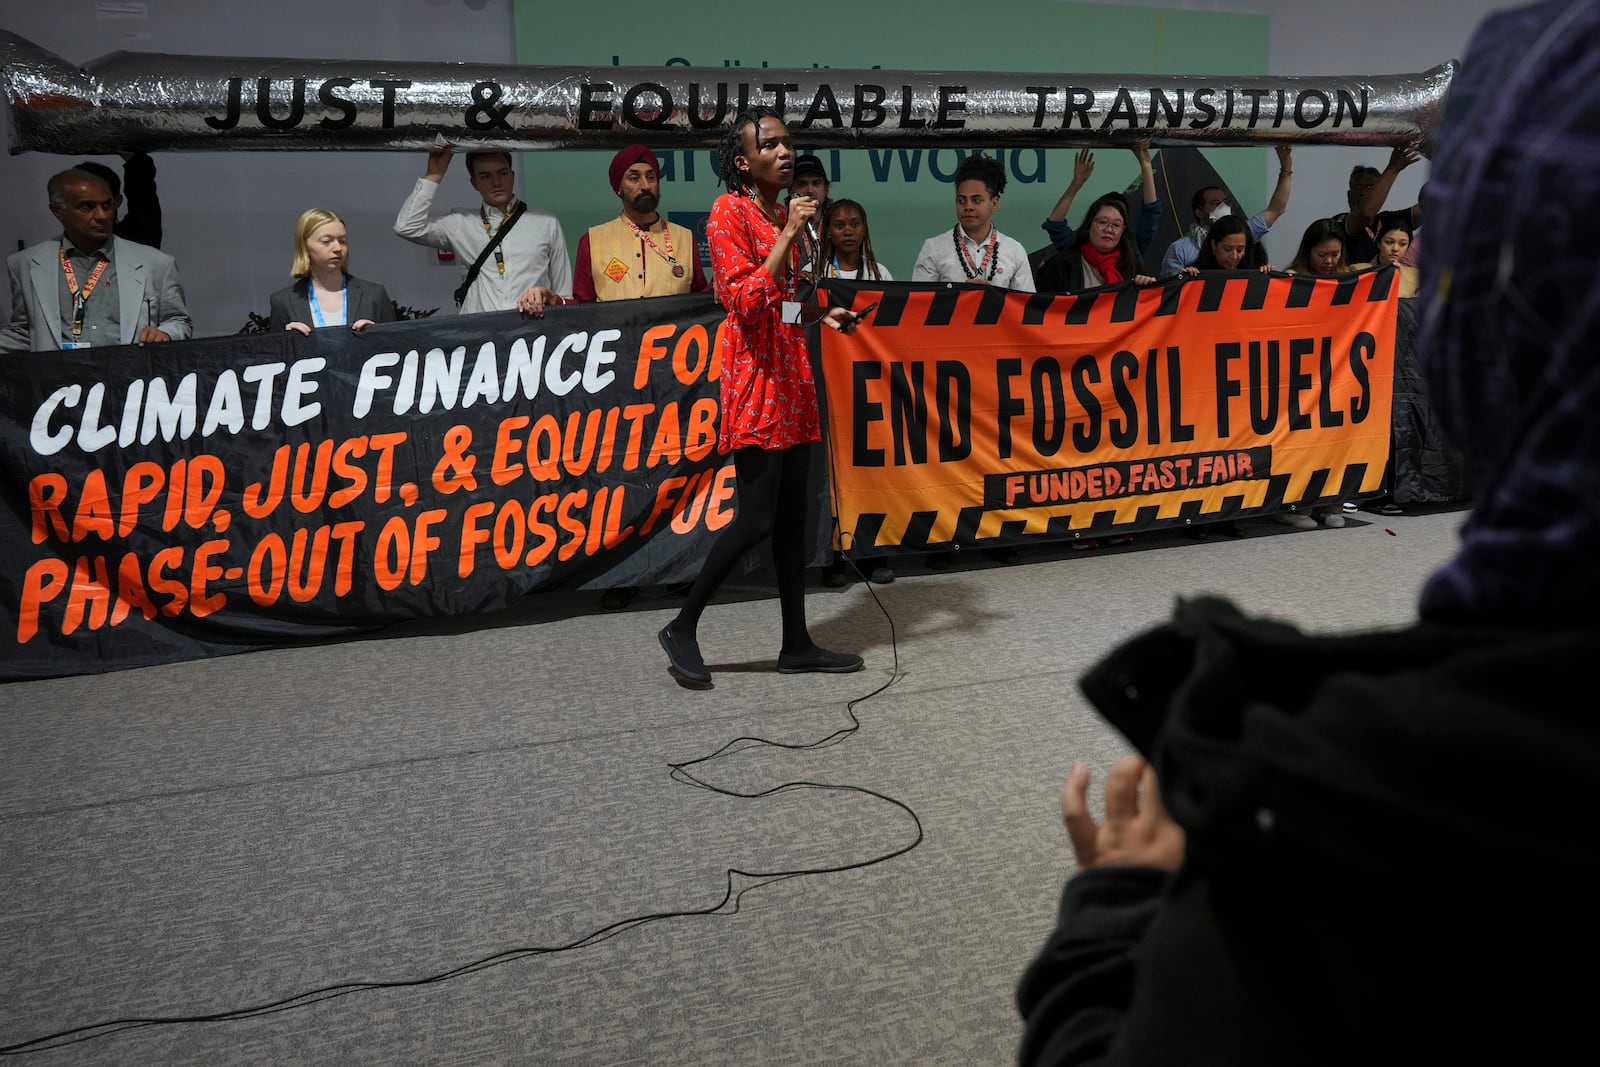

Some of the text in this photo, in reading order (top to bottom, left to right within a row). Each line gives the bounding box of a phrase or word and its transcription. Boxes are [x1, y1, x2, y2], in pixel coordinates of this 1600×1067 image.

[204, 76, 1369, 131] JUST & EQUITABLE TRANSITION
[29, 356, 328, 456] CLIMATE
[352, 328, 622, 419] FINANCE
[432, 424, 485, 495] &
[491, 397, 731, 488] EQUITAB
[852, 331, 1376, 467] END FOSSIL FUELS
[17, 520, 366, 644] PHASE-OUT
[375, 508, 448, 592] OF
[458, 485, 636, 579] FOSSIL
